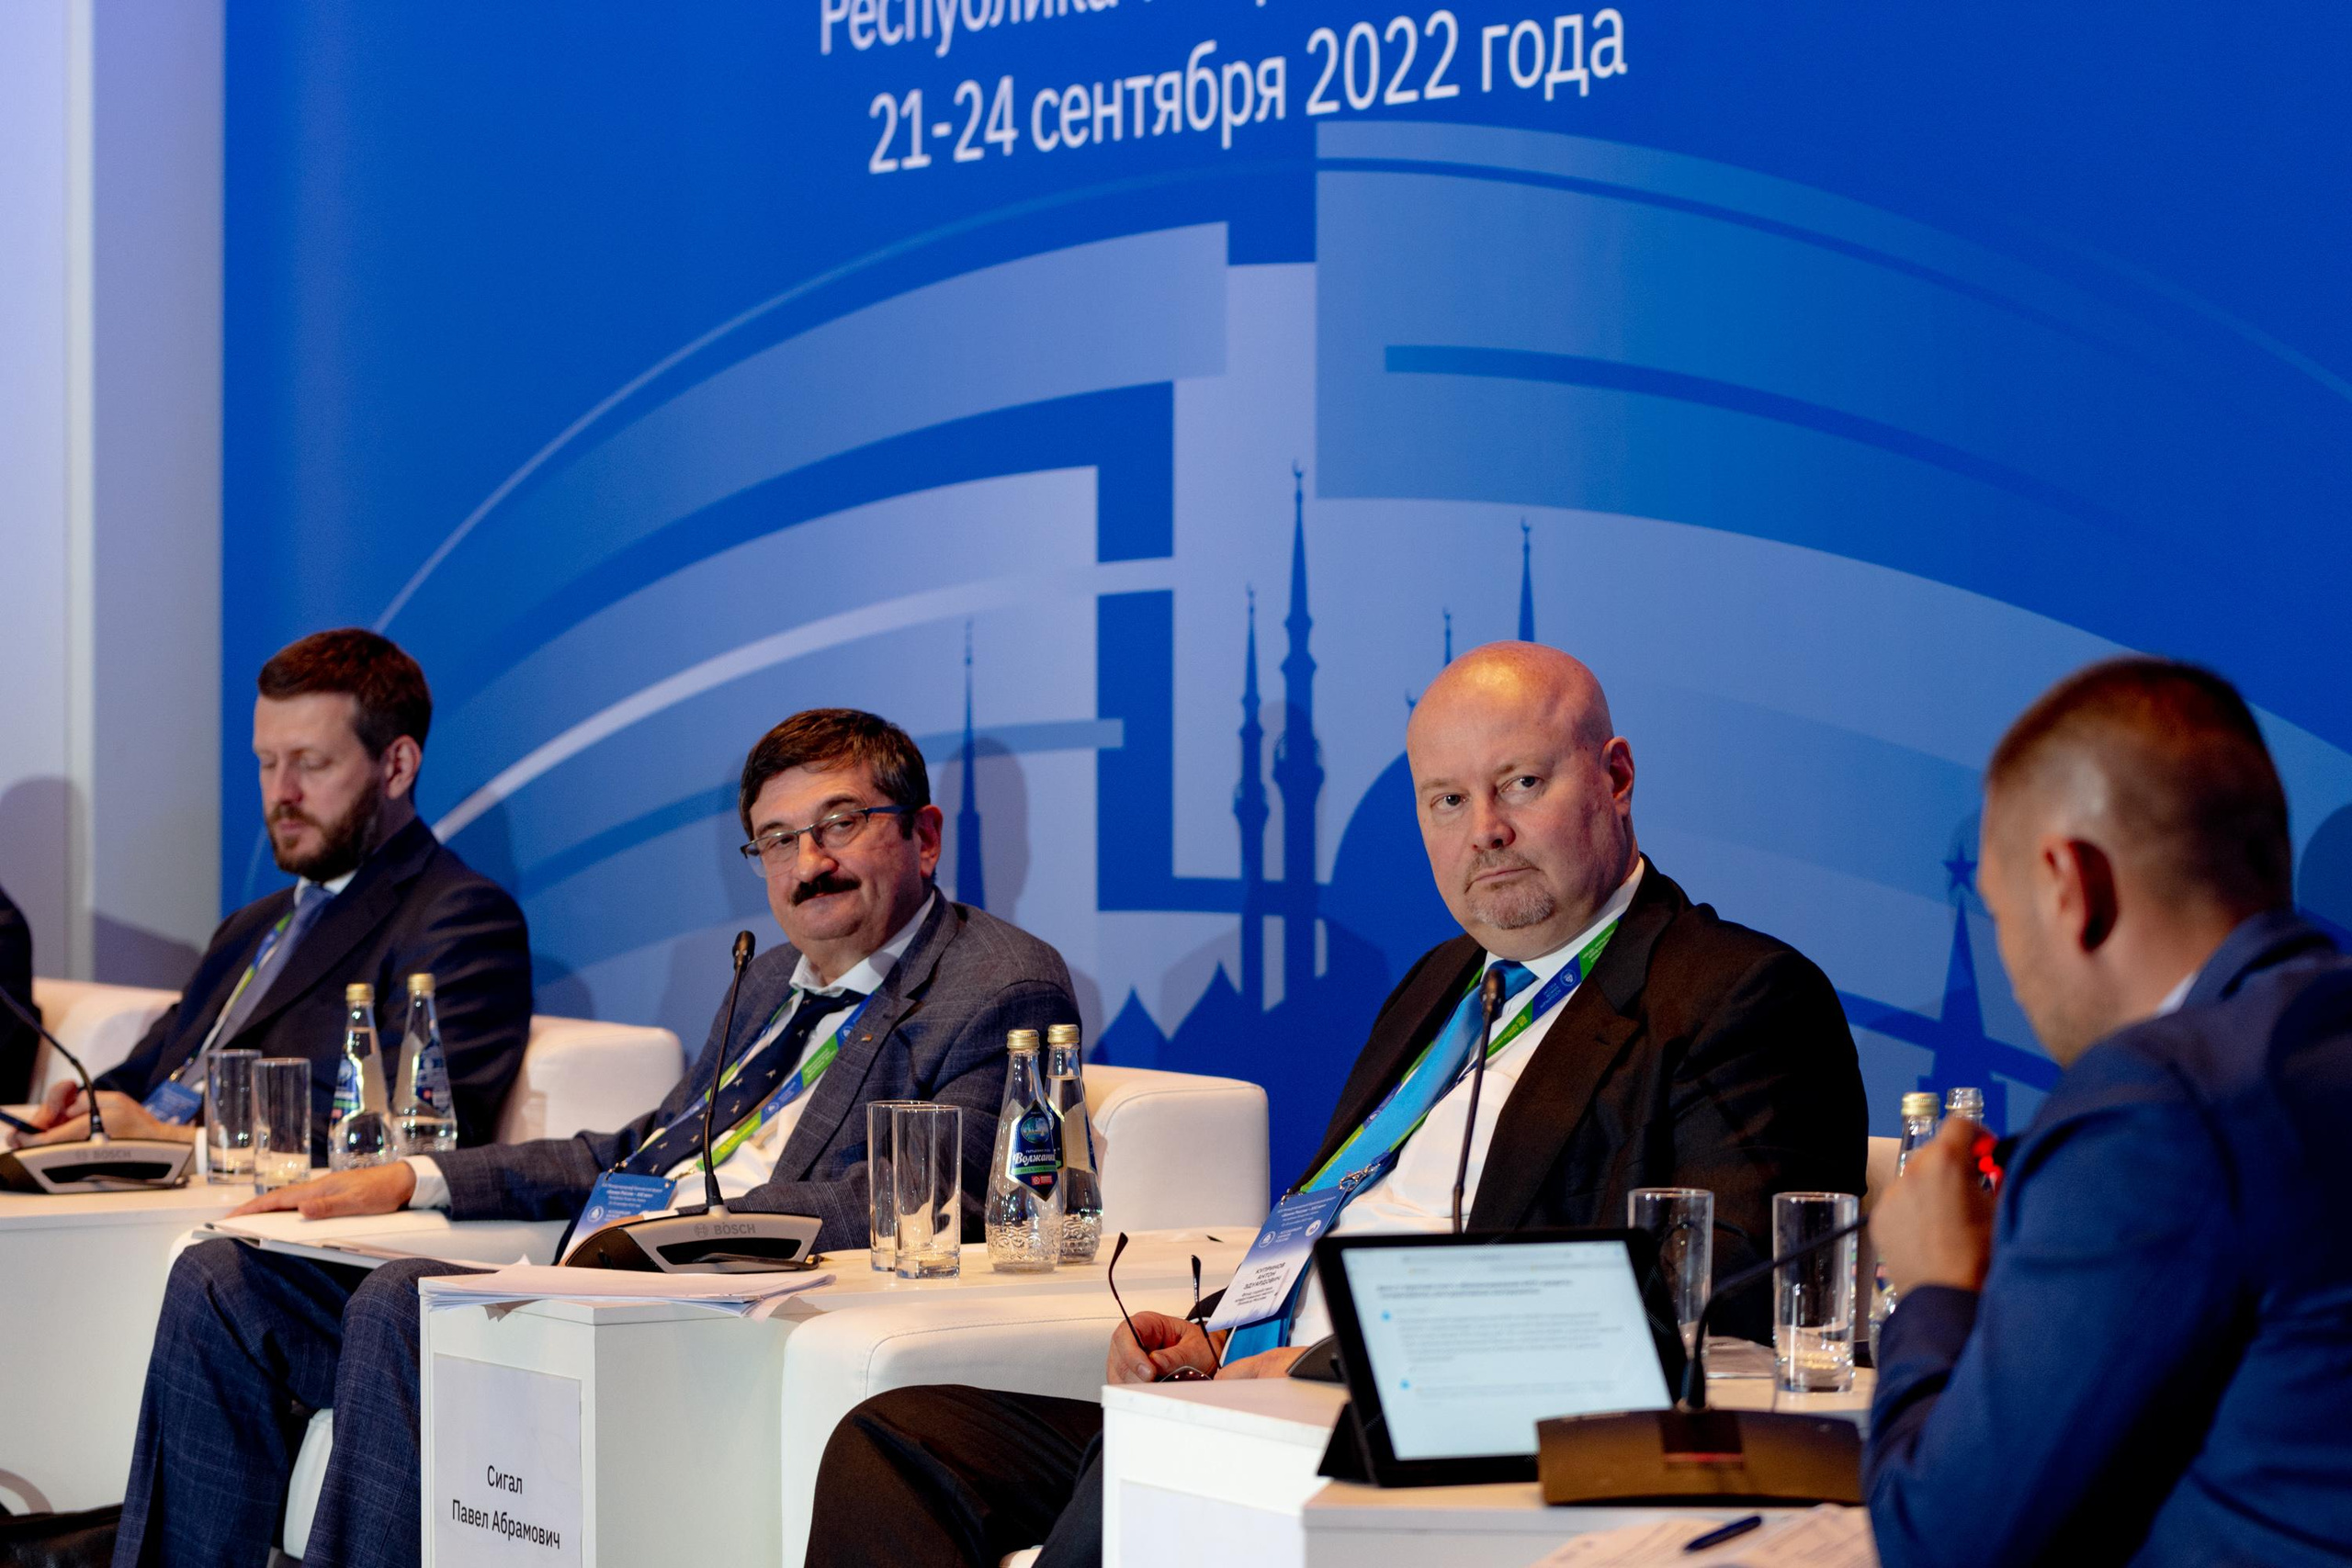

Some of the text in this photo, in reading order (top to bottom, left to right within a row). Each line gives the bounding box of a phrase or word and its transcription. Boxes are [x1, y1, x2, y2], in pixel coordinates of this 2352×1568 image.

[820, 0, 1119, 58] Респу
[868, 8, 1627, 175] 21-24 сентября 2022 года
[713, 1224, 756, 1235] BOSCH
[487, 1464, 523, 1495] Сигал
[452, 1498, 560, 1550] Павел Абрамович
